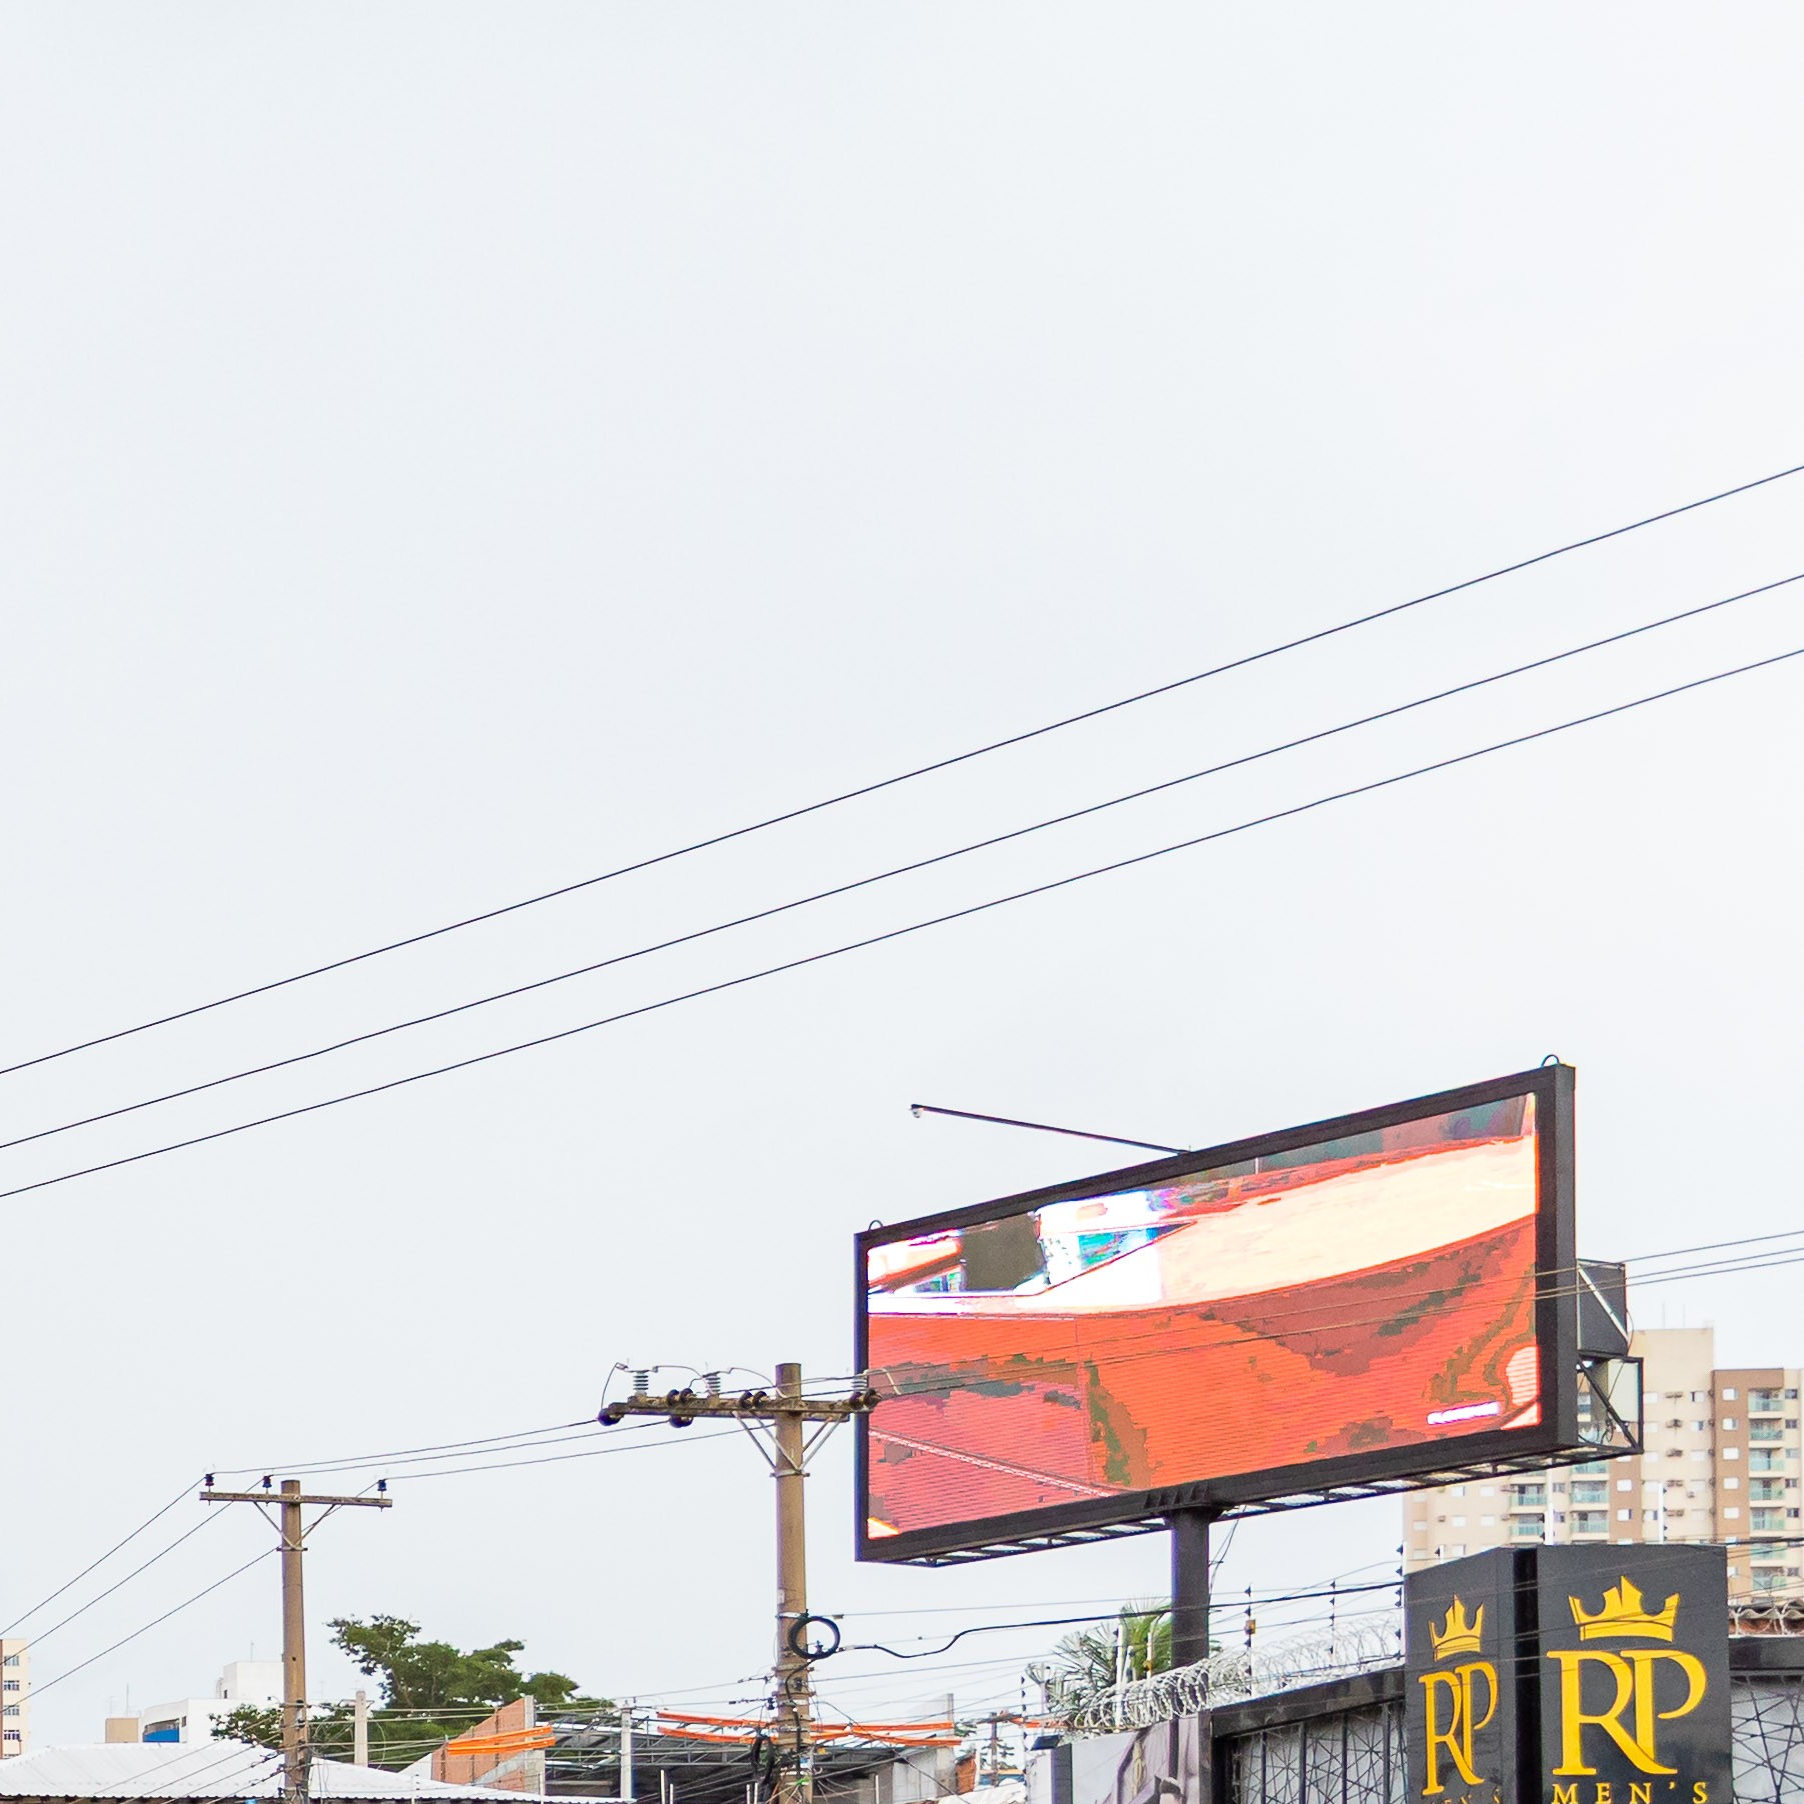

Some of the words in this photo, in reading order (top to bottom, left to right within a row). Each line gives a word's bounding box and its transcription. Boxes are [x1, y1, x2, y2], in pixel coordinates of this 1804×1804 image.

[1418, 1661, 1499, 1796] RP
[1546, 1649, 1707, 1775] RP
[1551, 1781, 1708, 1804] MEN'S
